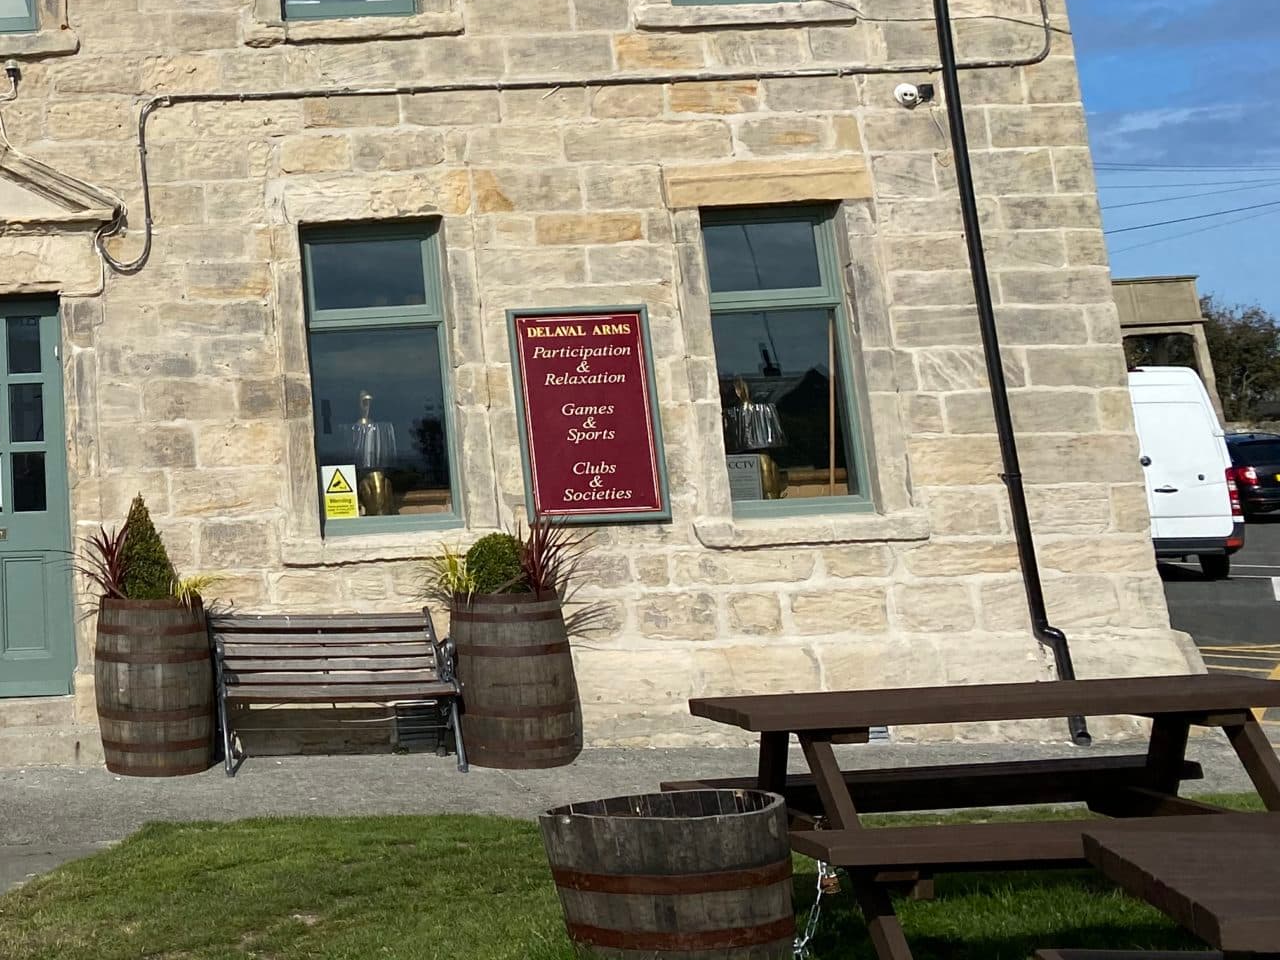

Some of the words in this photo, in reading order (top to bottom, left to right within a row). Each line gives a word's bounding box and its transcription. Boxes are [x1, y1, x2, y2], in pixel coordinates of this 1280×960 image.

[527, 325, 587, 338] DELAVAL
[592, 323, 631, 336] ARMS
[532, 344, 632, 360] Participation
[576, 359, 591, 373] &
[544, 372, 626, 386] Relaxation
[561, 403, 615, 416] Games
[582, 416, 597, 429] &
[567, 428, 616, 444] Sports
[572, 461, 617, 475] Clubs
[728, 461, 755, 469] CCTV
[588, 475, 604, 488] &
[563, 488, 633, 502] Societies
